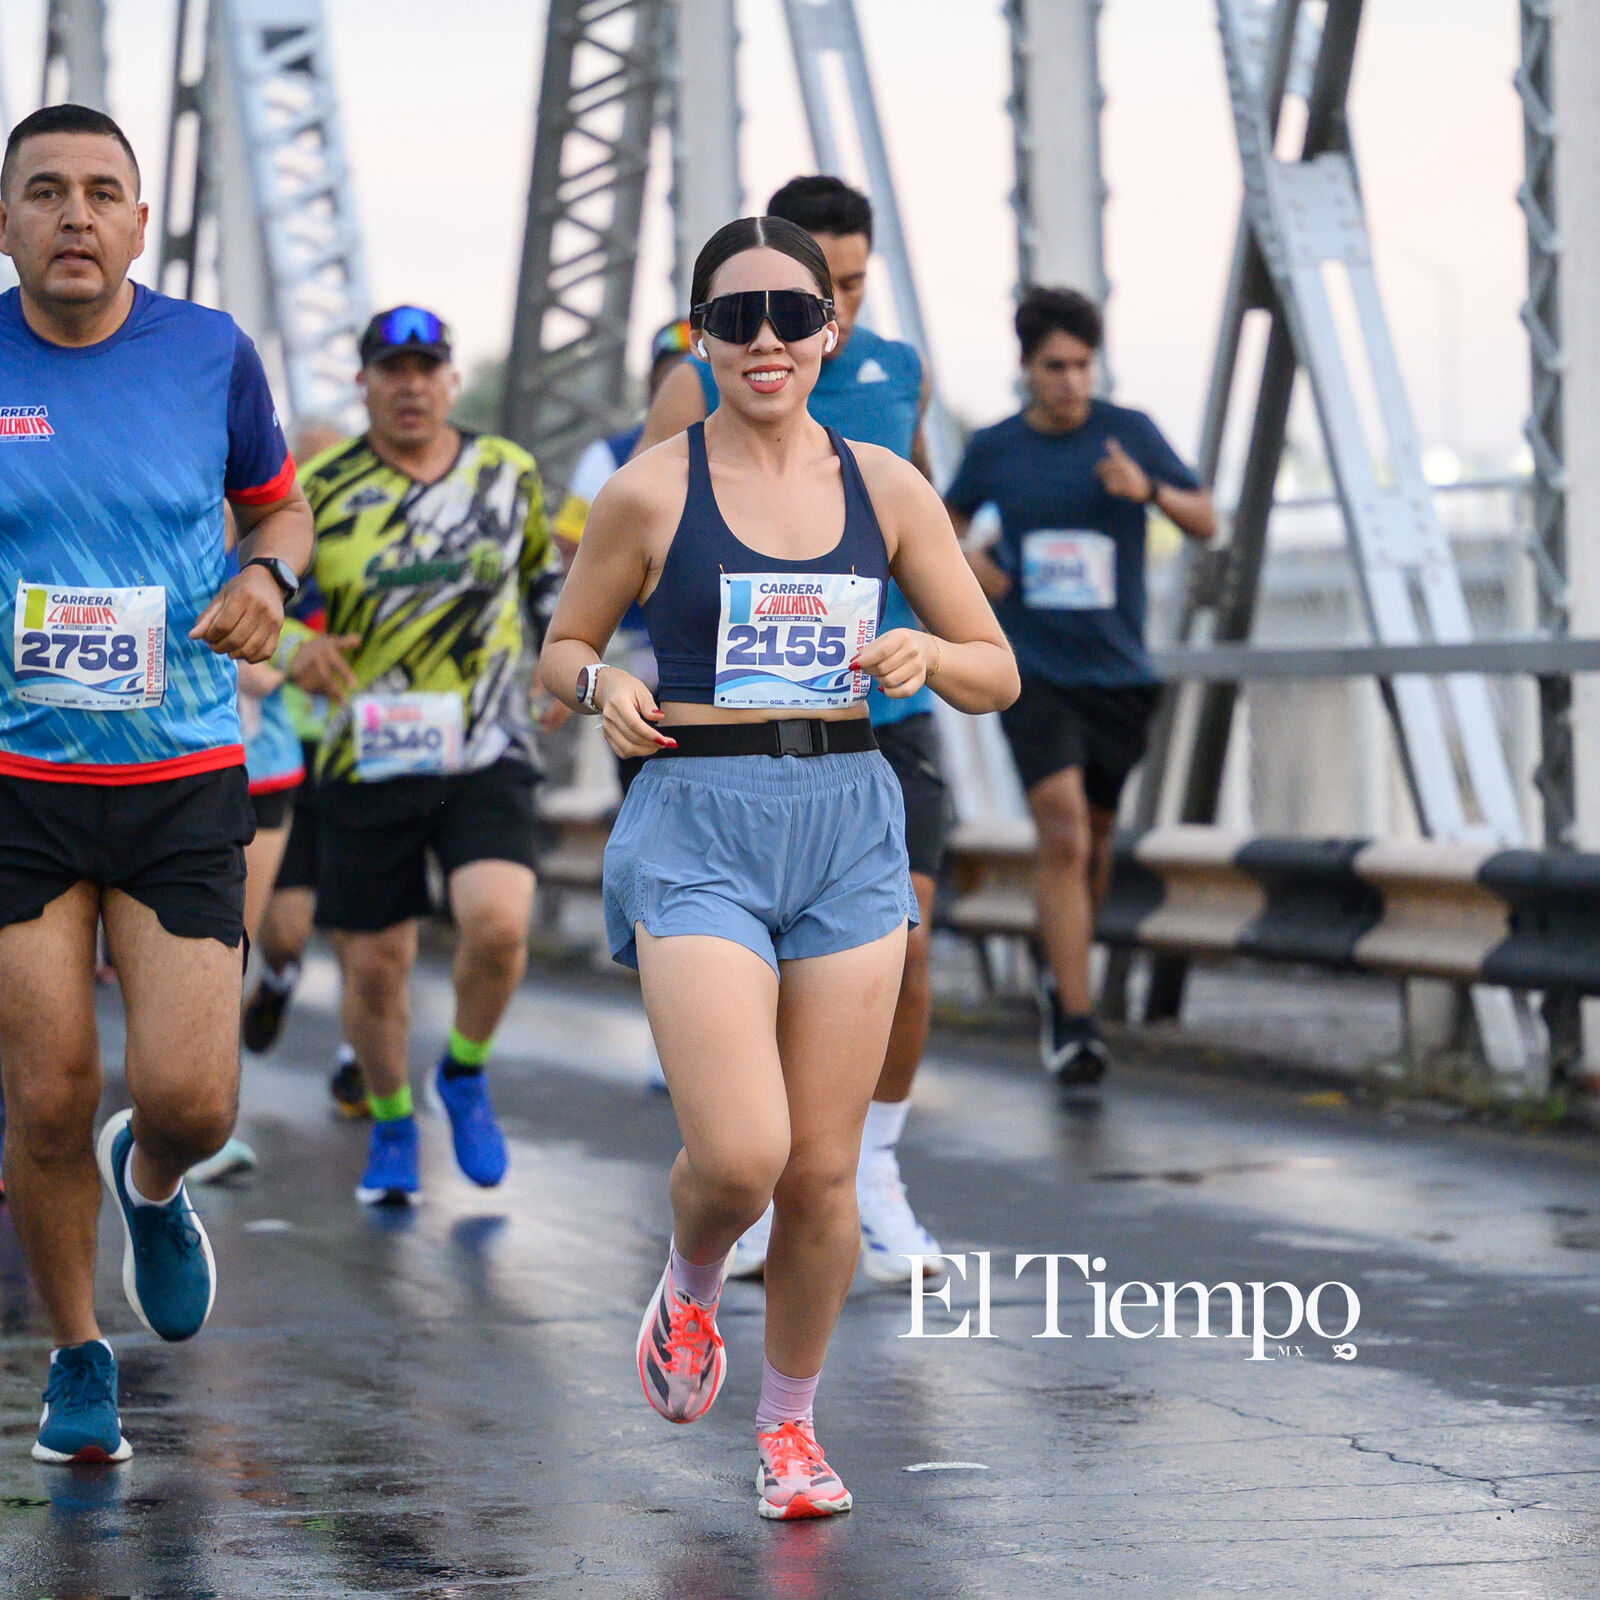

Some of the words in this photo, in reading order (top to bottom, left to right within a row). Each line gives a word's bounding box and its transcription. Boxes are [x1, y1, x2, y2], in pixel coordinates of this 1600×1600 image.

[759, 583, 824, 595] CARRERA
[52, 594, 113, 606] CARRERA
[753, 595, 829, 616] CHILCHOTA
[47, 605, 118, 624] CHILCHOTA
[147, 627, 156, 642] KIT
[858, 619, 867, 636] KIT
[21, 631, 138, 671] 2758
[725, 624, 847, 667] 2155
[146, 651, 156, 695] ENTREGA
